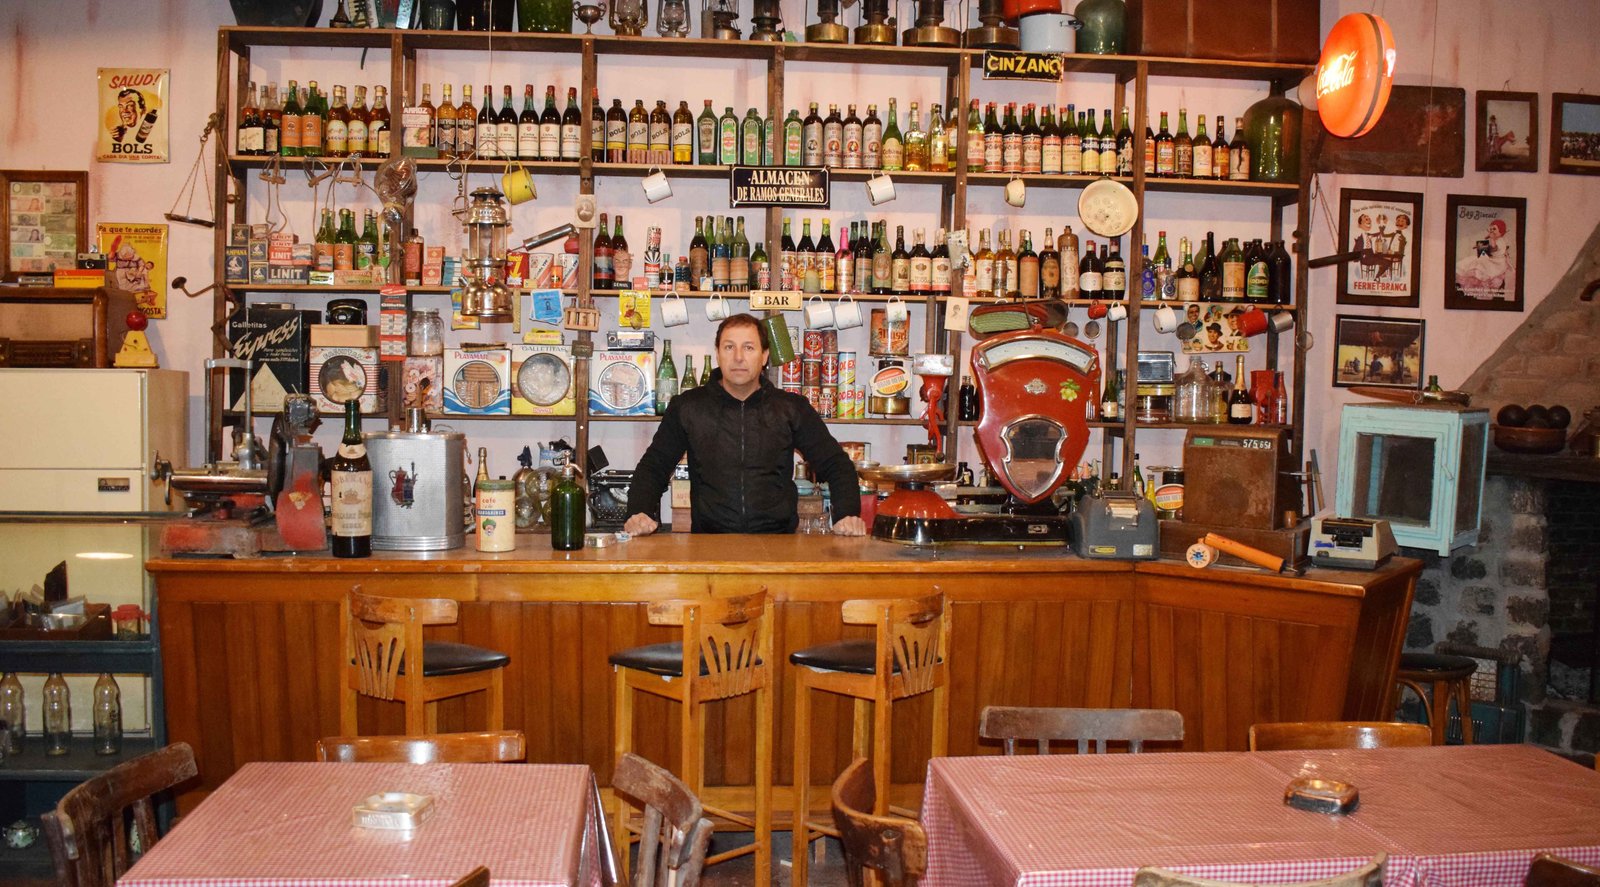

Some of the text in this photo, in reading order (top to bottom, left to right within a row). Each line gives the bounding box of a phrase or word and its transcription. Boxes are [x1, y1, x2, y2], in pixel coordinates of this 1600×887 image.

[987, 55, 1061, 75] CINZANO
[109, 73, 161, 89] SALUD!
[592, 125, 604, 135] OLS
[608, 126, 626, 137] BOLS
[630, 127, 647, 139] BOLS
[651, 127, 669, 140] BOLS
[673, 128, 691, 140] BOLS
[112, 143, 153, 154] BOLS
[750, 170, 811, 186] ALMACEN
[737, 186, 824, 202] DE RAMOS GENERALES
[98, 225, 107, 233] Pa
[109, 226, 123, 234] que
[133, 226, 162, 234] acordes
[271, 252, 291, 260] LINIT
[271, 268, 303, 279] LINIT
[1353, 281, 1407, 292] FERNET-BRANCA
[763, 296, 789, 306] BAR
